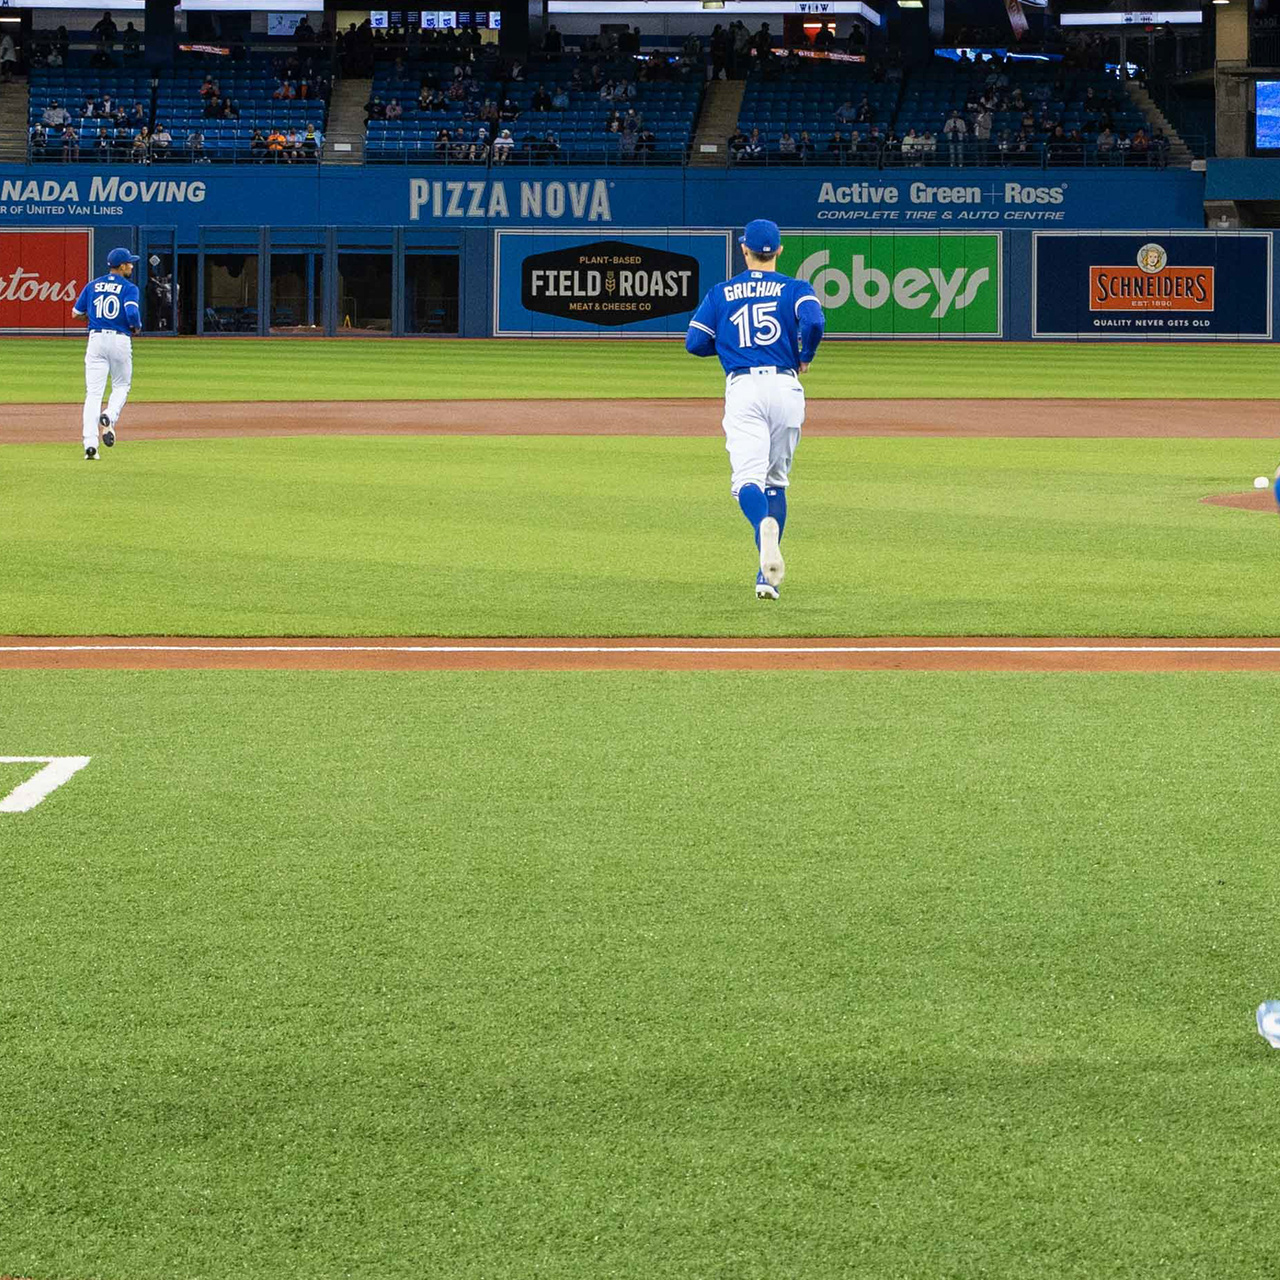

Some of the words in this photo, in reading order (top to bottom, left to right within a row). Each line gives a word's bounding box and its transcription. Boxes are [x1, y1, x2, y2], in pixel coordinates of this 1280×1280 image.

[409, 178, 510, 220] PIZZA
[521, 179, 611, 221] NOVA
[818, 183, 898, 203] Active
[817, 211, 899, 219] COMPLETE
[905, 211, 937, 219] TIRE
[942, 211, 952, 219] &
[957, 211, 999, 219] AUTO
[532, 271, 601, 296] FIELD
[620, 271, 691, 296] ROAST
[723, 281, 786, 302] GRICHUK
[1095, 273, 1207, 303] SCHNEIDERS
[93, 294, 120, 320] 10
[730, 302, 781, 347] 15
